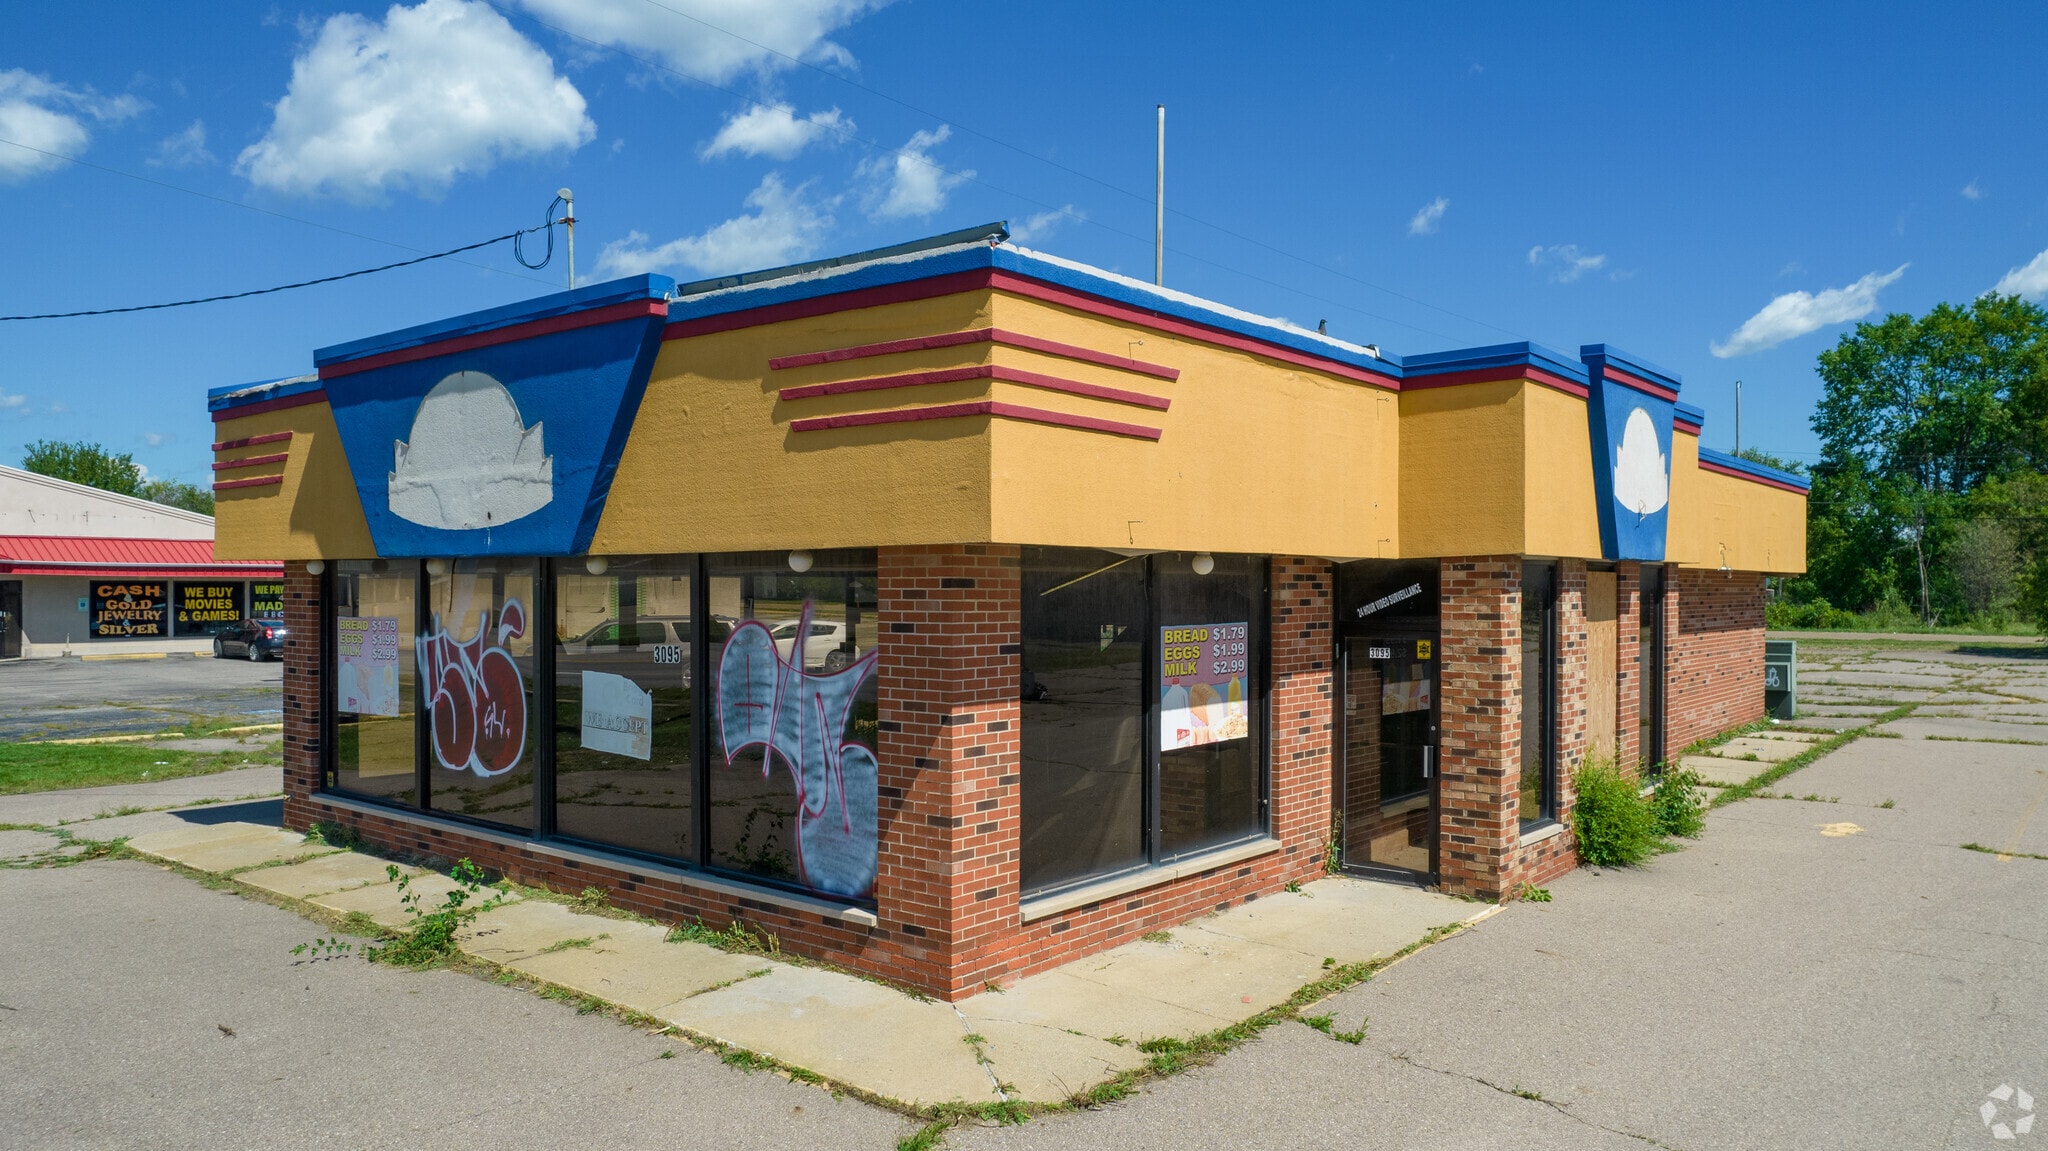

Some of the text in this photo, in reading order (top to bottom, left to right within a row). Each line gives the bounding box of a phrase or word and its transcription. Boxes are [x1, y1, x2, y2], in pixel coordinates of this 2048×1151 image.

[97, 585, 160, 597] CASH
[184, 587, 233, 597] WE BUY
[254, 585, 268, 595] WE
[105, 599, 152, 610] GOLD
[185, 599, 233, 609] MOVIES
[1363, 602, 1377, 616] HOUR
[1375, 597, 1390, 610] VIDEO
[1388, 583, 1422, 605] SURVEILLANCE
[96, 610, 162, 624] JEWELRY
[178, 610, 239, 621] & GAMES!
[99, 624, 159, 635] SILVER
[340, 620, 396, 632] BREAD $1.79
[340, 633, 396, 646] EGGS $1.99
[1164, 626, 1245, 644] BREAD $1.79
[340, 645, 396, 660] MILK $2.99
[654, 646, 680, 663] 3095
[1164, 642, 1245, 661] EGGS $1.99
[1370, 648, 1390, 658] 3095
[1164, 659, 1245, 677] MILK $2.99
[607, 714, 648, 735] ACCEPT
